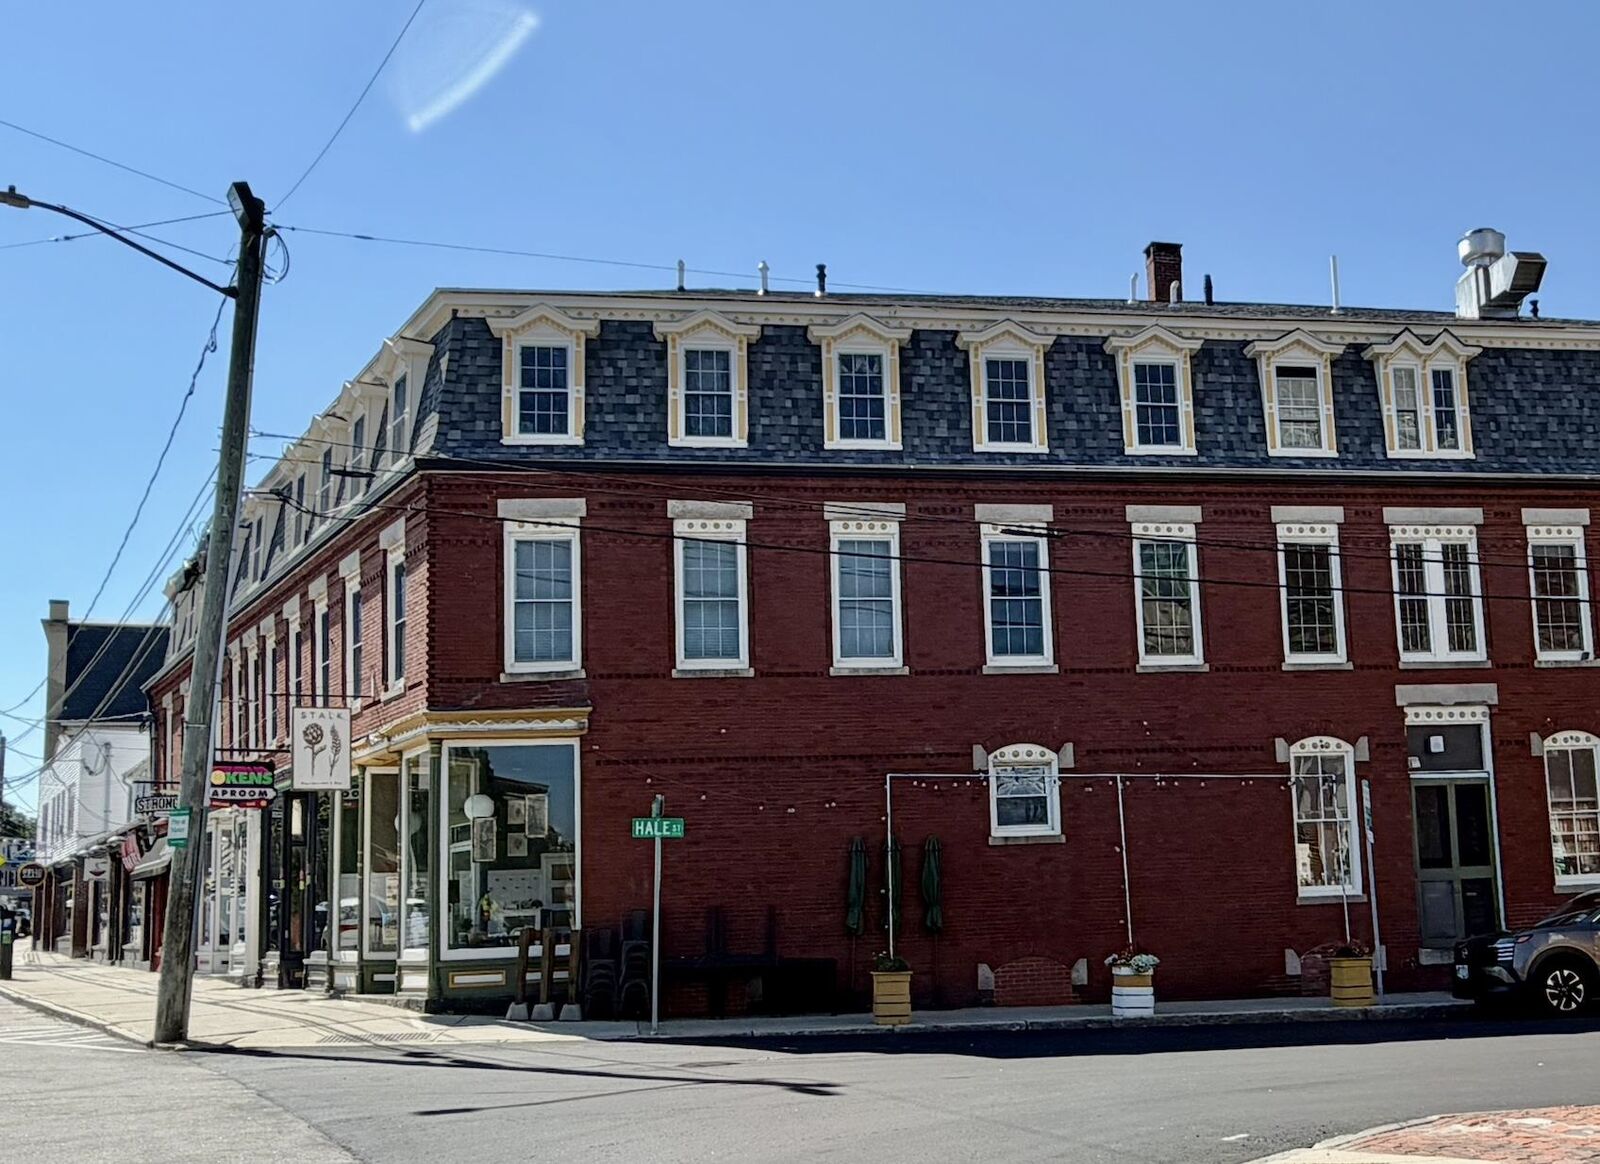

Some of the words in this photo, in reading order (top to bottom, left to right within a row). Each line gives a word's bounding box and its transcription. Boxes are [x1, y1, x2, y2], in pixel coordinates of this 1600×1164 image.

[301, 711, 345, 720] STALK
[211, 789, 268, 798] APROOM
[635, 820, 671, 835] HALE
[672, 824, 682, 832] ST
